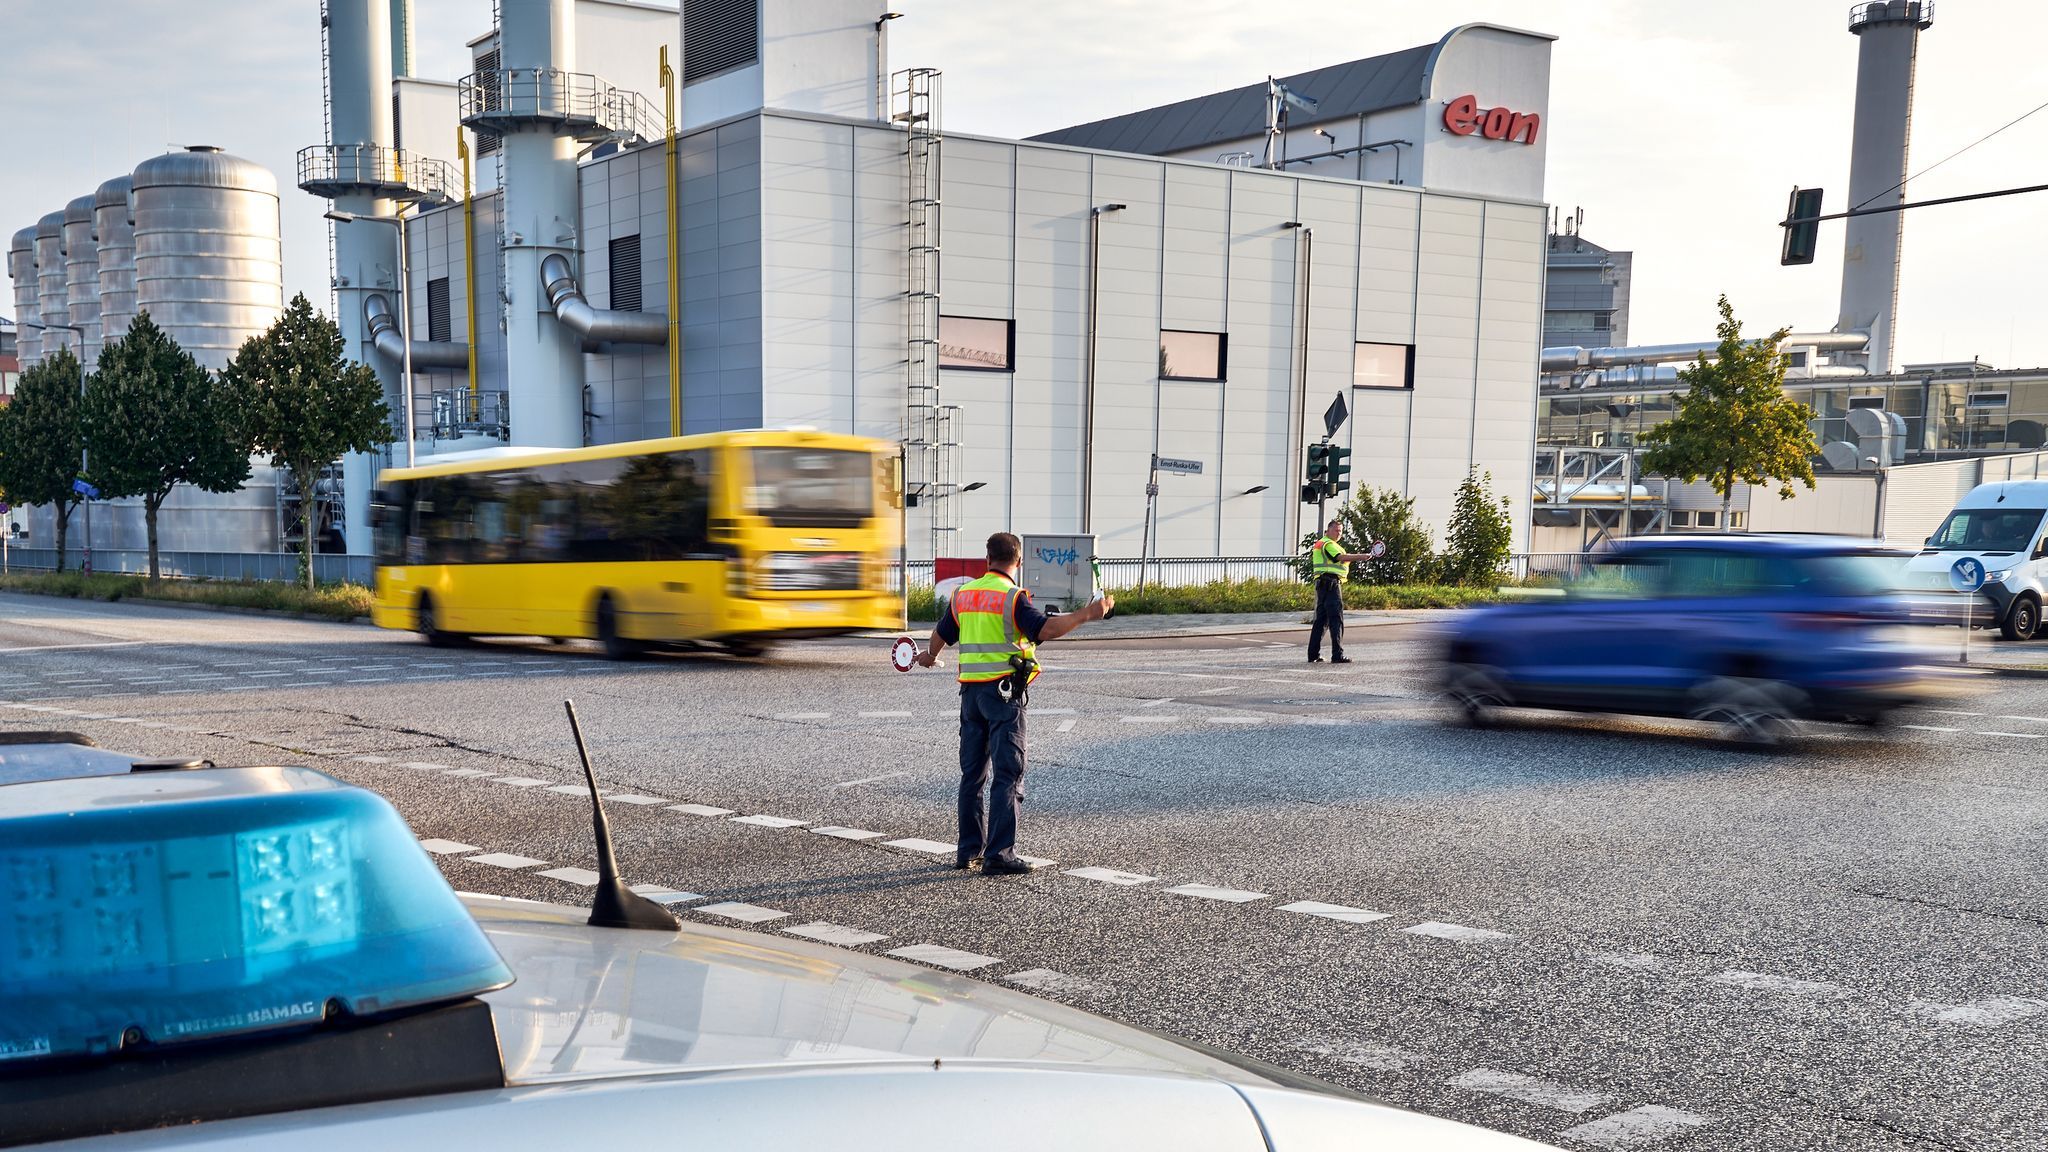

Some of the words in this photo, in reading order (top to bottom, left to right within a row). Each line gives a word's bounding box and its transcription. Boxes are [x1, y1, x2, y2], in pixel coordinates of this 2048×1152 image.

[1161, 460, 1200, 470] Ernst-Ruska-Ufer
[957, 591, 1003, 611] POLIZEI
[247, 1001, 314, 1024] BAMAG
